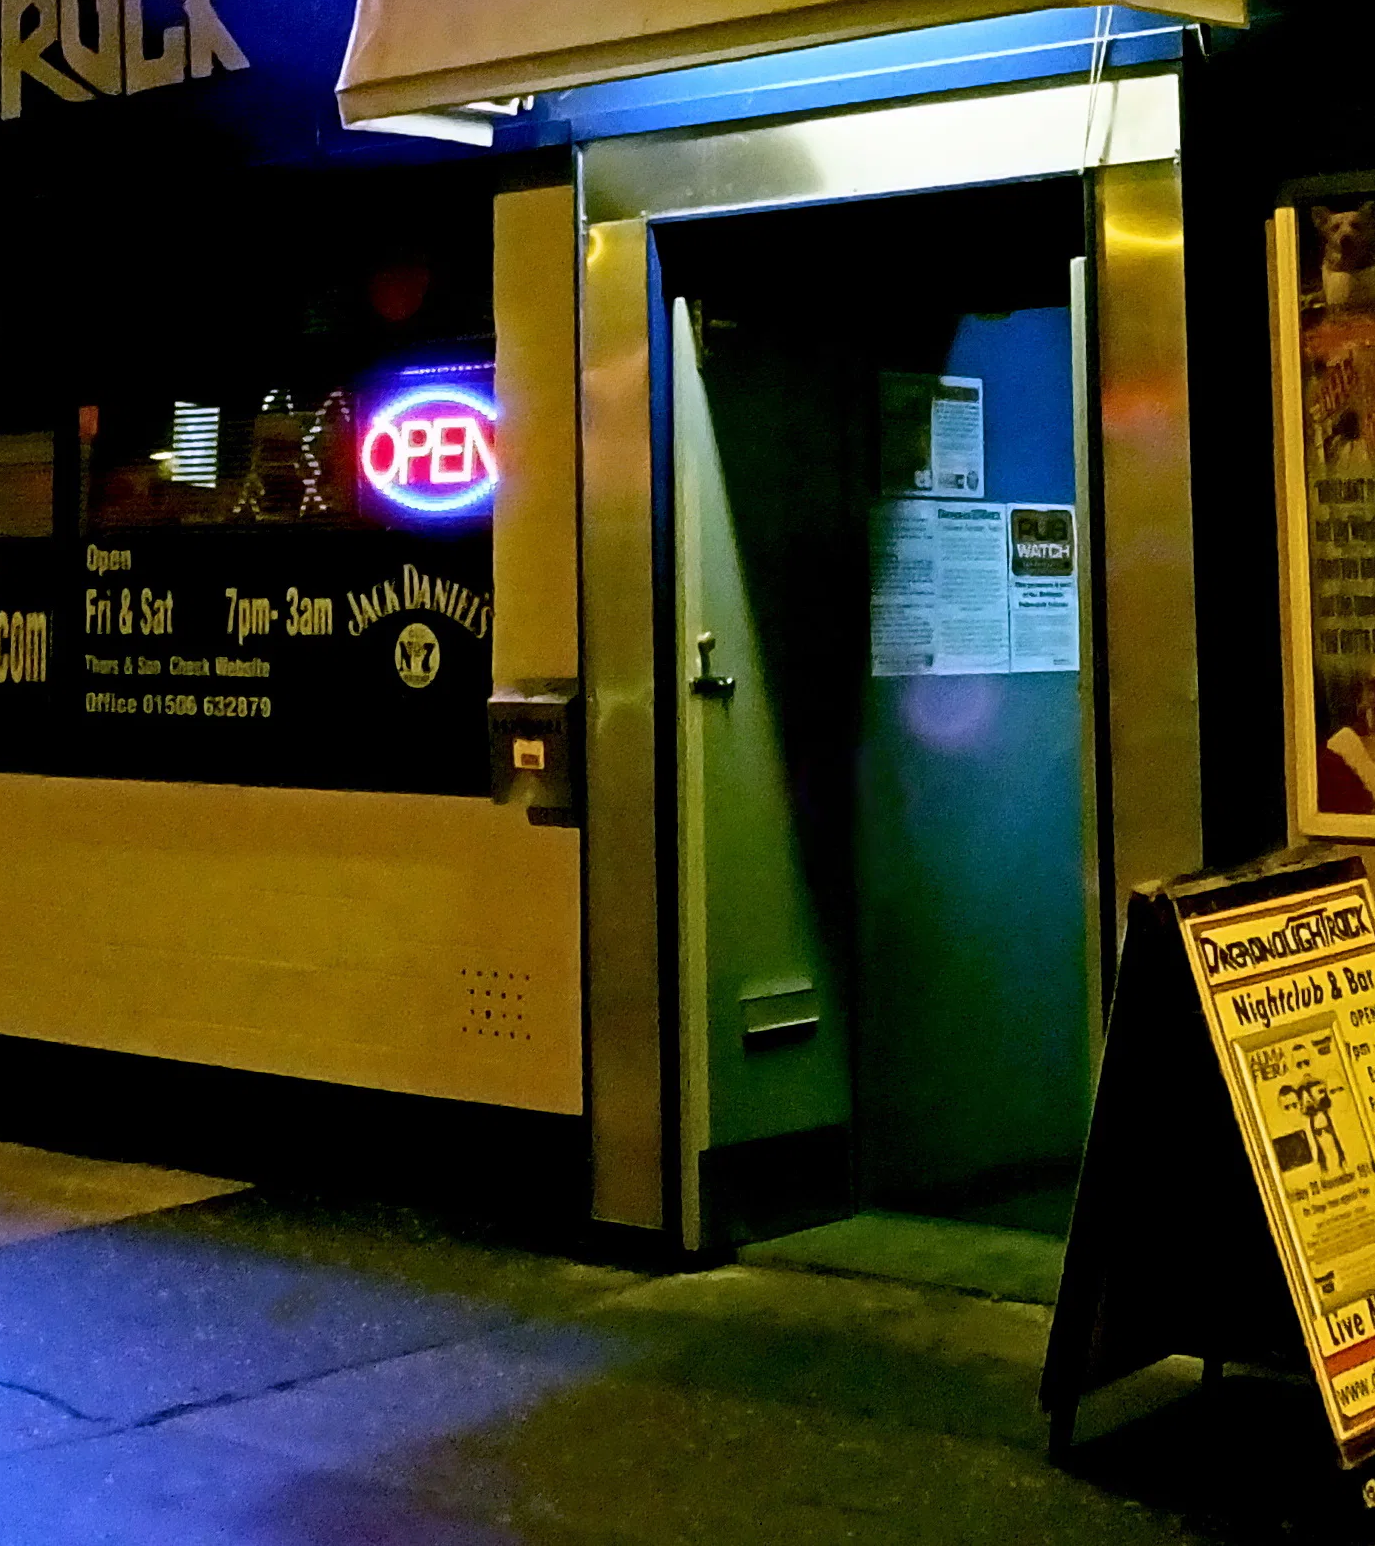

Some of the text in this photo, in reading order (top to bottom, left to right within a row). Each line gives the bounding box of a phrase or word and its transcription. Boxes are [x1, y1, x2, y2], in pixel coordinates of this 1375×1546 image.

[362, 417, 499, 492] OPEN
[87, 544, 131, 576] Open
[1017, 543, 1071, 560] WATCH
[86, 588, 112, 635] Fri
[119, 587, 133, 635] &
[140, 587, 174, 636] Sat
[286, 586, 334, 636] 3am
[347, 578, 401, 637] JACK
[86, 692, 138, 714] Office
[1231, 966, 1375, 1028] Nightclub & Bar
[1325, 1312, 1366, 1347] Live
